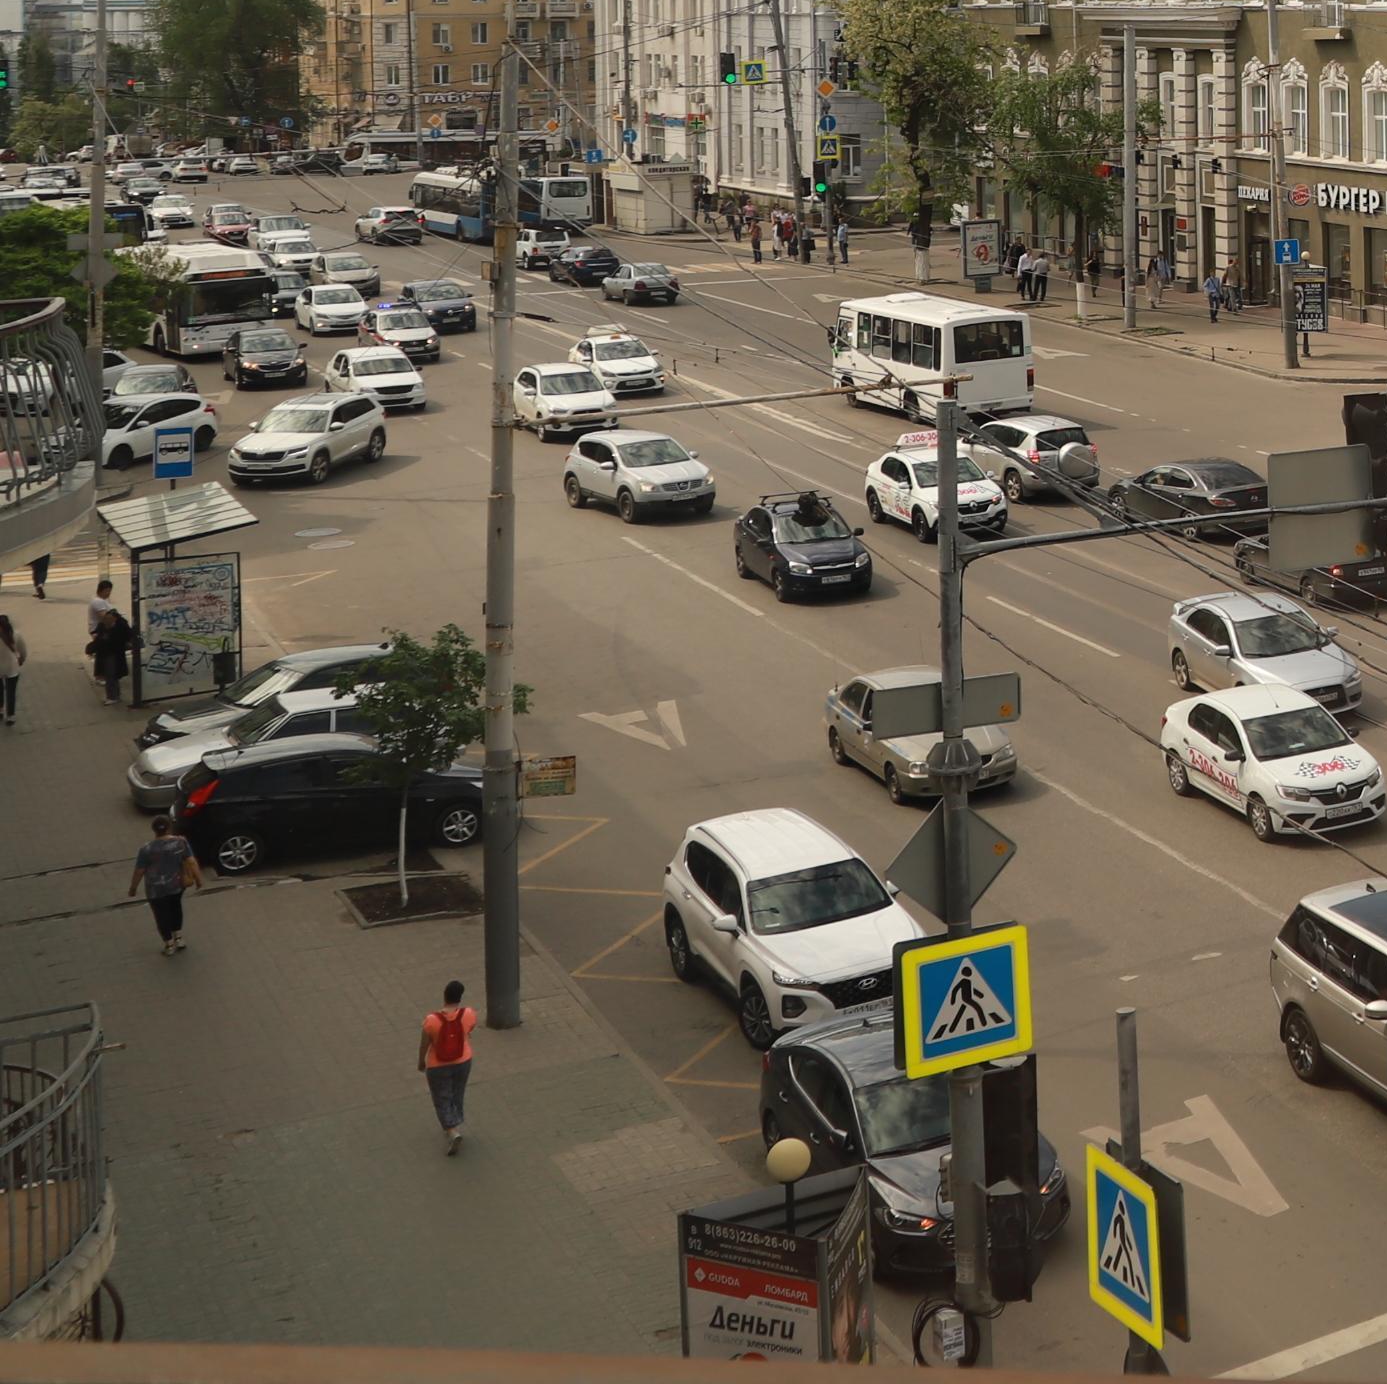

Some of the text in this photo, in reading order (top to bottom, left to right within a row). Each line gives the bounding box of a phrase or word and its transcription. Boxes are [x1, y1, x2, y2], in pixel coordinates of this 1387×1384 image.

[1317, 183, 1380, 214] БУРГЕР
[688, 1237, 702, 1250] 912
[704, 1223, 797, 1253] 8(863)226-26-00
[708, 1272, 740, 1287] GUDDA
[764, 1283, 808, 1303] ЛОМБАРД
[709, 1305, 795, 1340] Деньги
[746, 1340, 802, 1356] электроники
